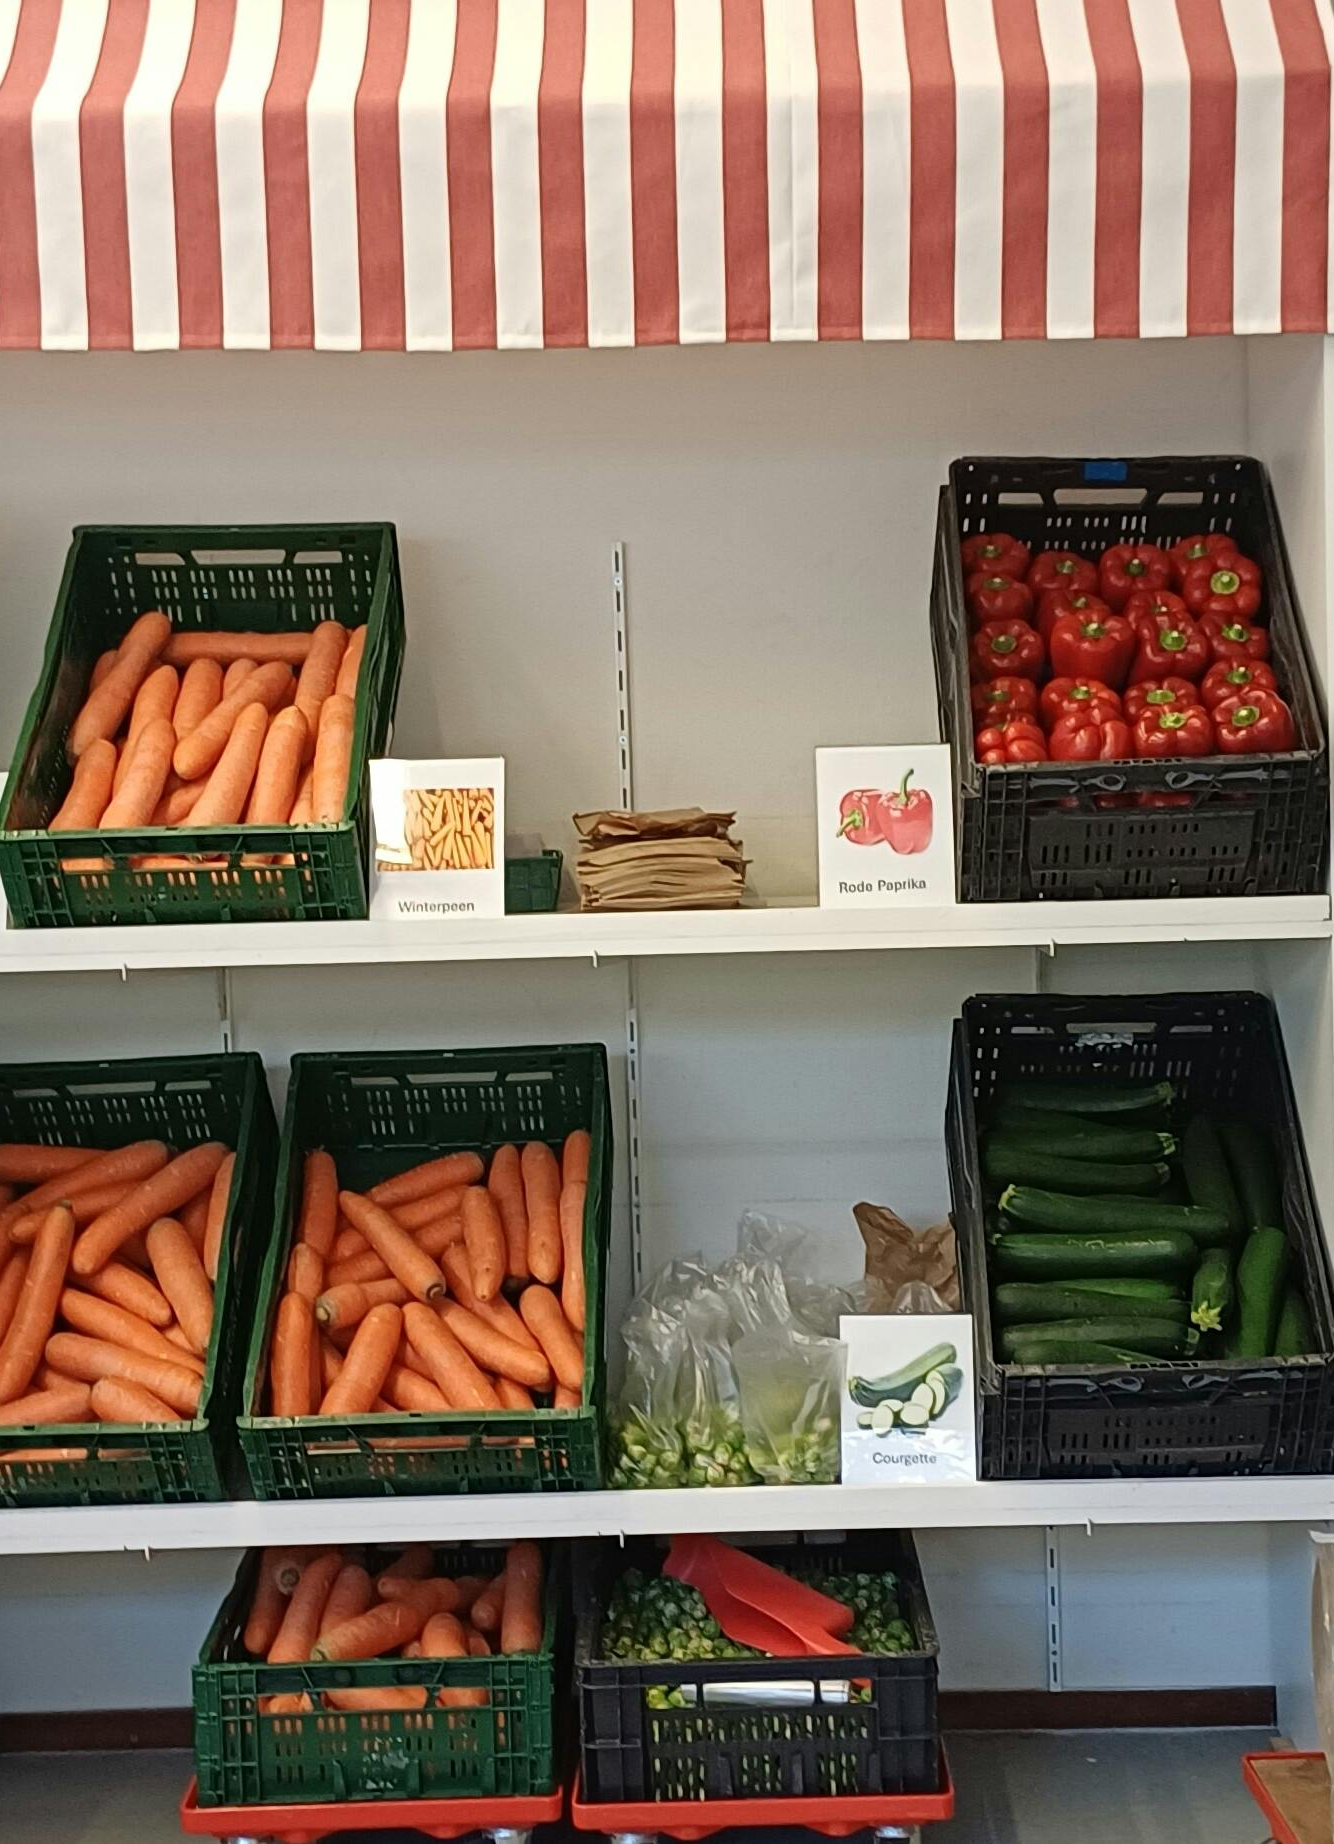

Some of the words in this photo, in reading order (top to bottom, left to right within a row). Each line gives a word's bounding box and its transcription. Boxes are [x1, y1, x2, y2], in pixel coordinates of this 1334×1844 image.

[839, 881, 873, 894] Rode
[878, 878, 927, 893] Paprika
[398, 900, 475, 914] Winterpeen
[872, 1452, 937, 1466] Courgette
